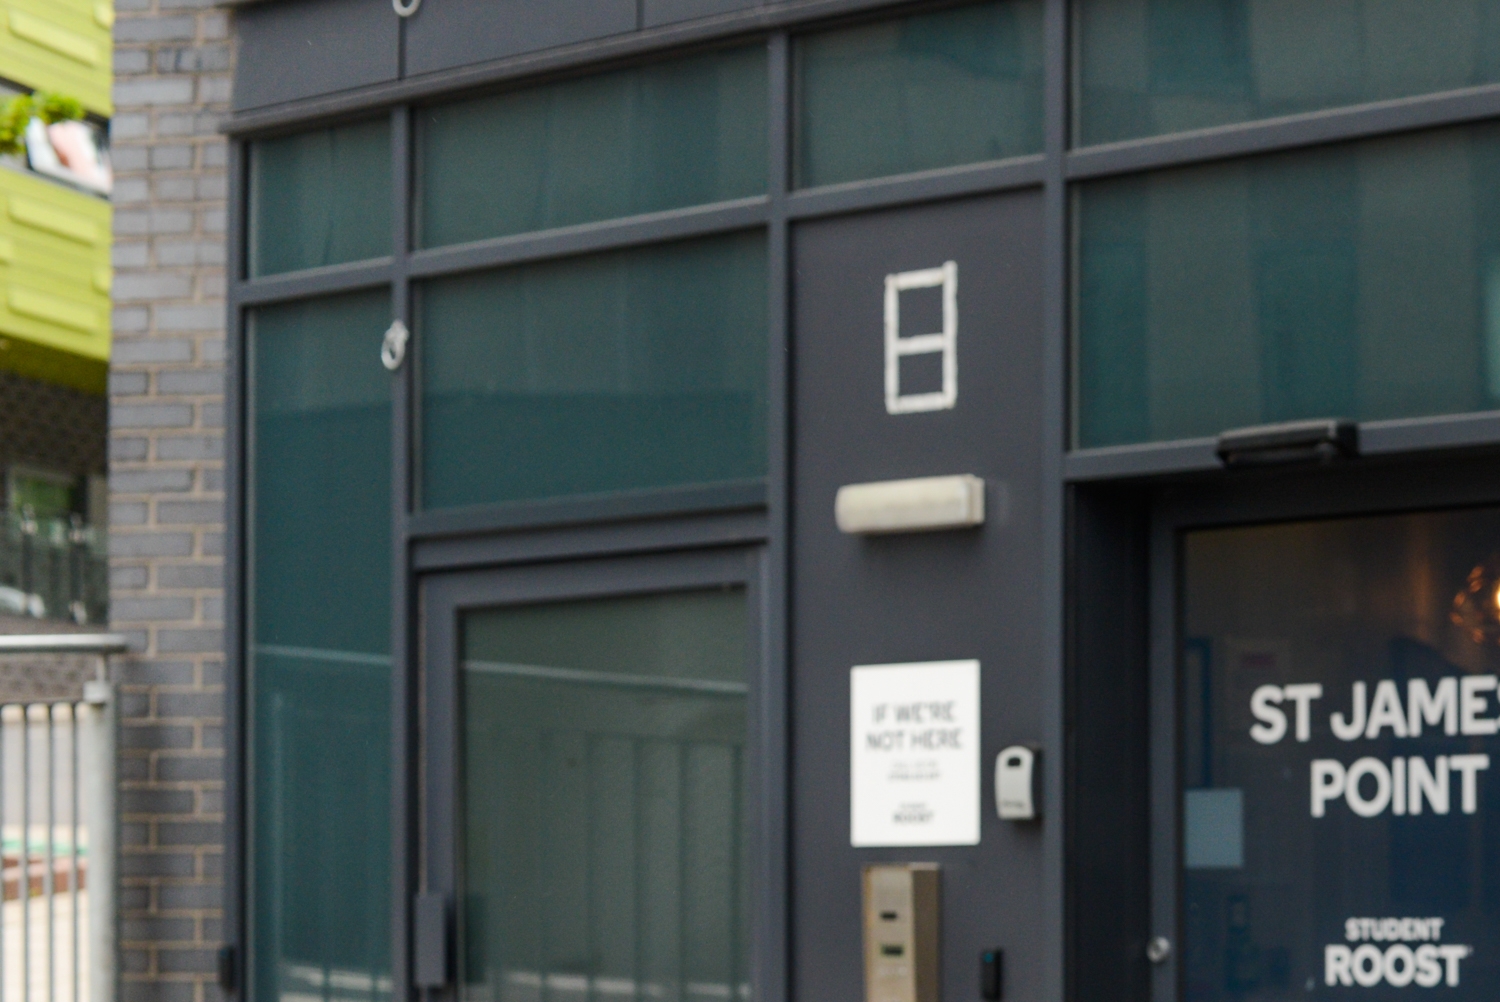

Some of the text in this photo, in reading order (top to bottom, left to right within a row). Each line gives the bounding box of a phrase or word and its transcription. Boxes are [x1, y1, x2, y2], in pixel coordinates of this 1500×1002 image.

[1250, 683, 1322, 744] ST
[865, 728, 964, 752] NOT HERE
[1310, 754, 1490, 818] POINT
[1345, 917, 1444, 941] STUDENT
[1324, 944, 1468, 988] ROOST
